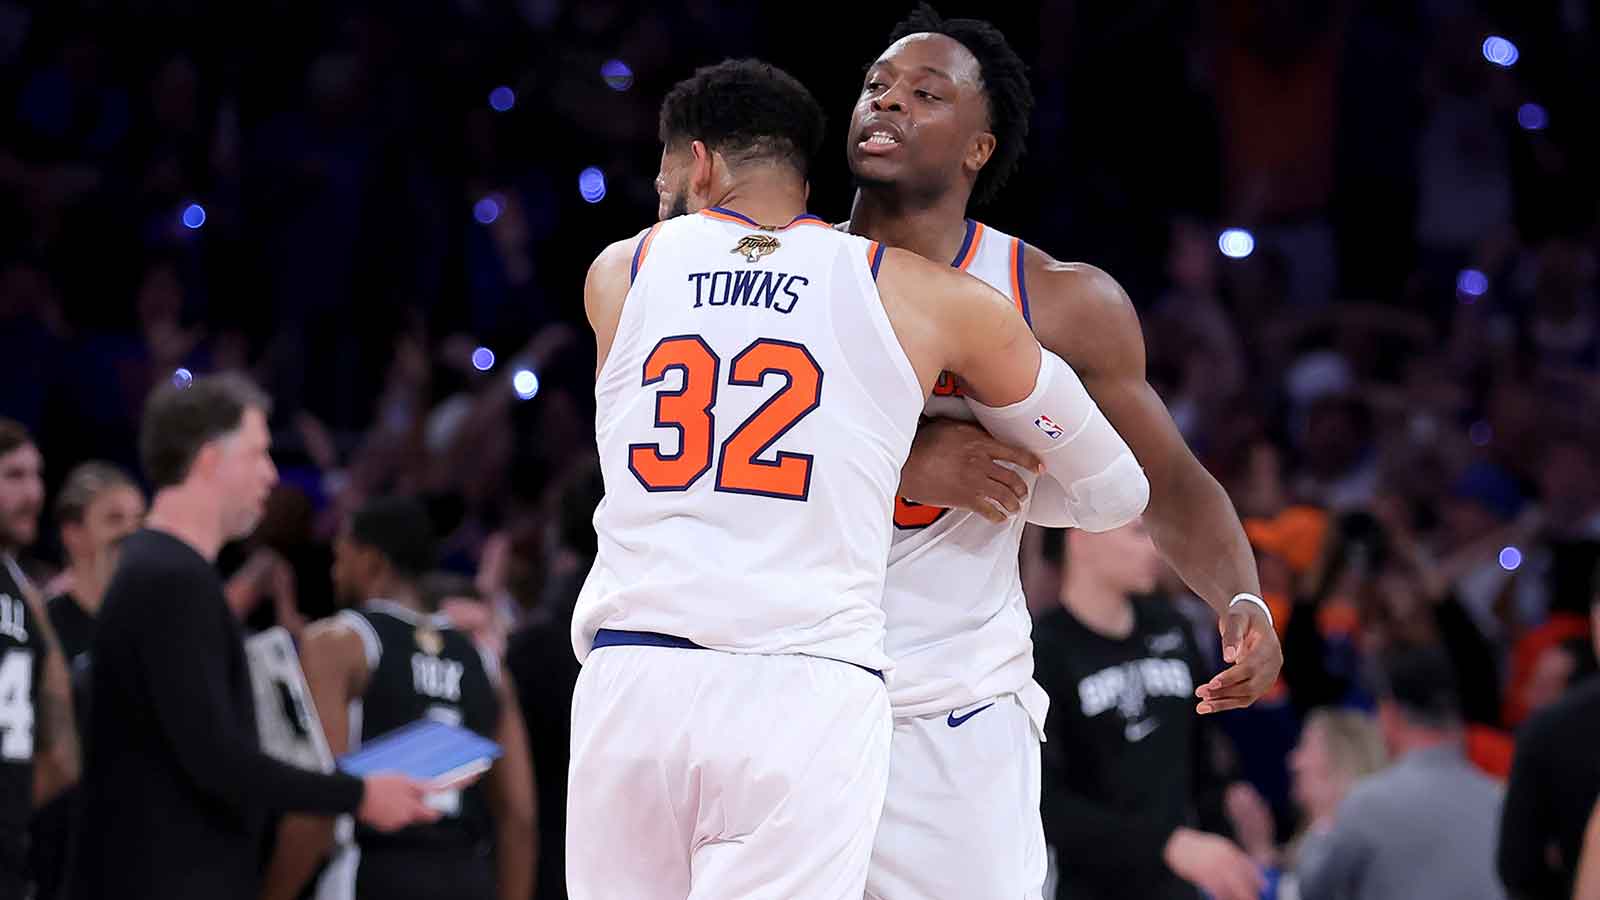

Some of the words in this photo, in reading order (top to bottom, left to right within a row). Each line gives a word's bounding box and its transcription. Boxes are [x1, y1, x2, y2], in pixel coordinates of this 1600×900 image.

[730, 235, 780, 253] Finals
[688, 270, 809, 314] TOWNS
[628, 334, 824, 502] 32
